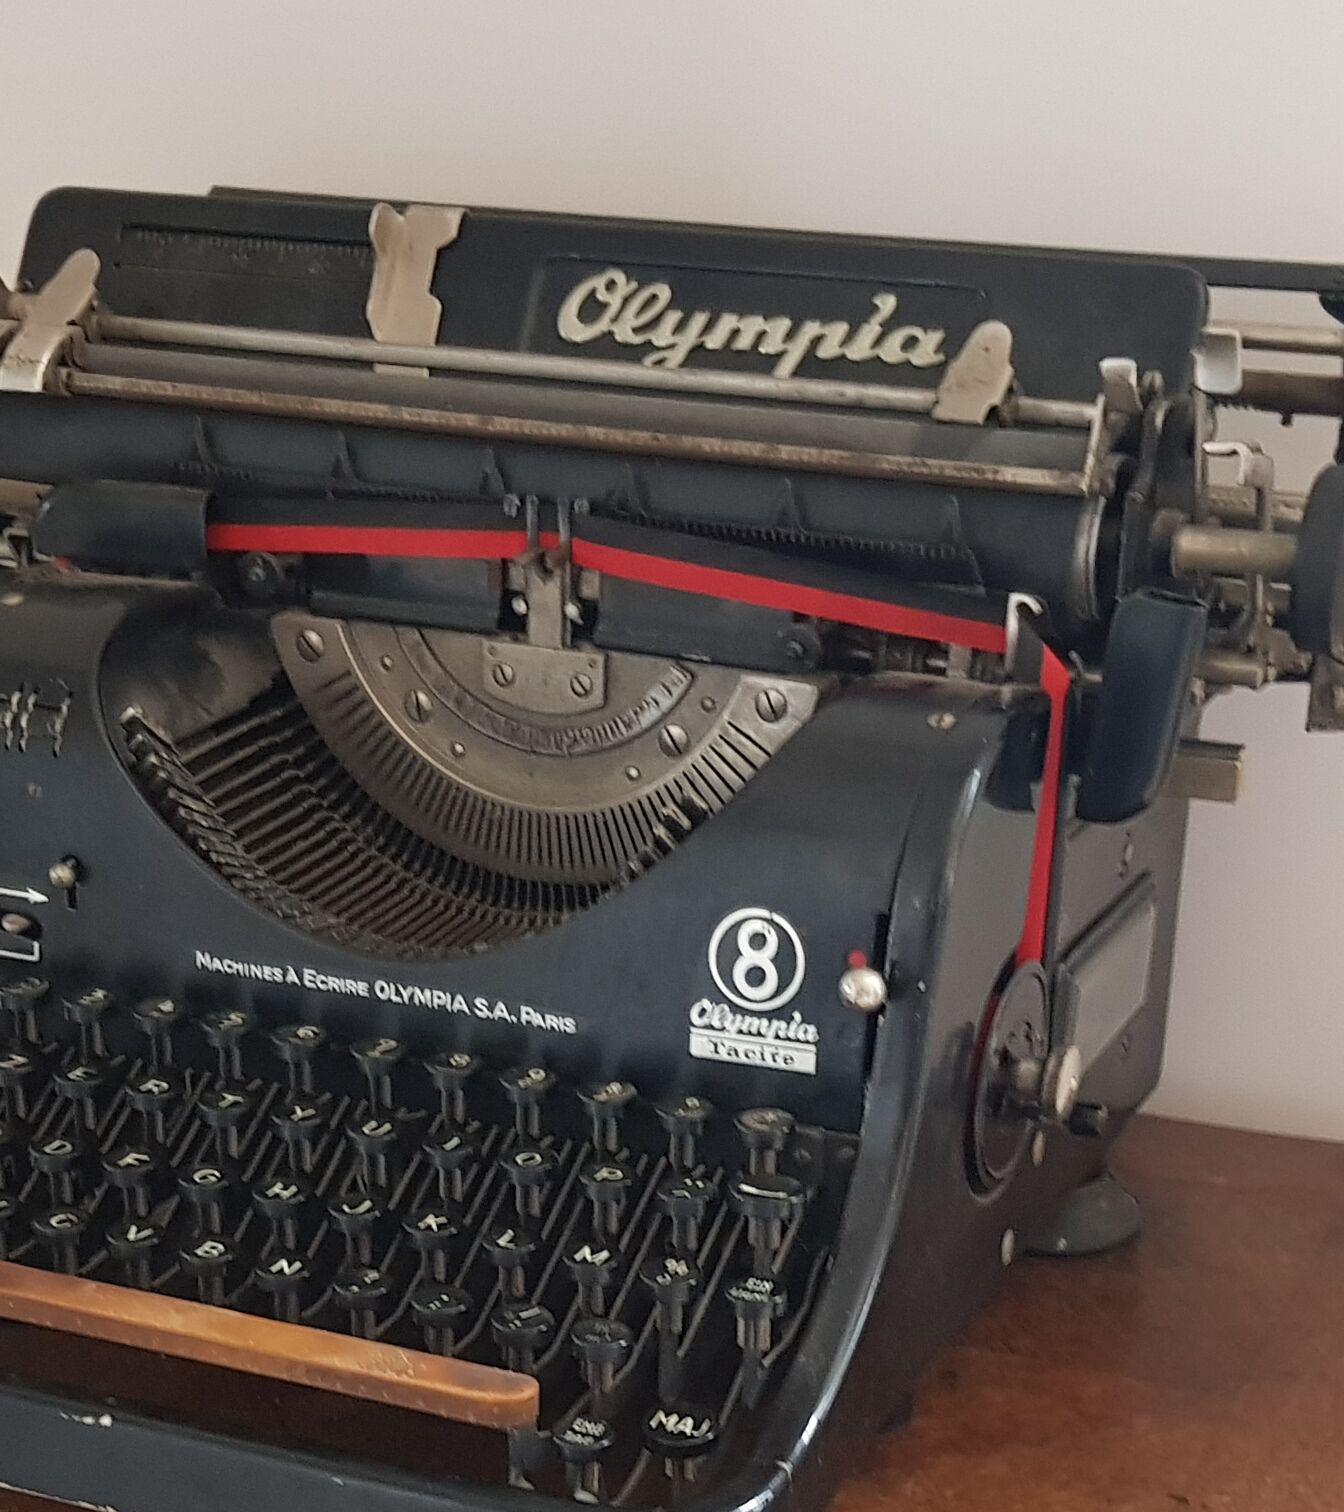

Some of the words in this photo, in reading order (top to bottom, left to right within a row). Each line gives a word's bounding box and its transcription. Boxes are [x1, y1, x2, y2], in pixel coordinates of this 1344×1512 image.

[556, 266, 946, 379] Olympia
[732, 919, 779, 1001] 8
[374, 979, 471, 1016] OLYMPIA
[520, 1005, 577, 1034] PARIS
[689, 998, 820, 1043] Olympia
[138, 1078, 170, 1095] R
[289, 1105, 317, 1122] Y
[362, 1120, 393, 1136] U
[514, 1151, 543, 1168] O
[593, 1166, 624, 1182] P
[43, 1139, 74, 1155] D
[116, 1152, 151, 1168] F
[192, 1168, 222, 1184] G
[265, 1181, 299, 1199] H
[418, 1213, 448, 1233] K
[496, 1229, 517, 1250] L
[49, 1212, 79, 1229] C
[127, 1224, 154, 1242] V
[193, 1240, 226, 1258] B
[268, 1257, 303, 1276] N
[649, 1409, 712, 1438] MAJ
